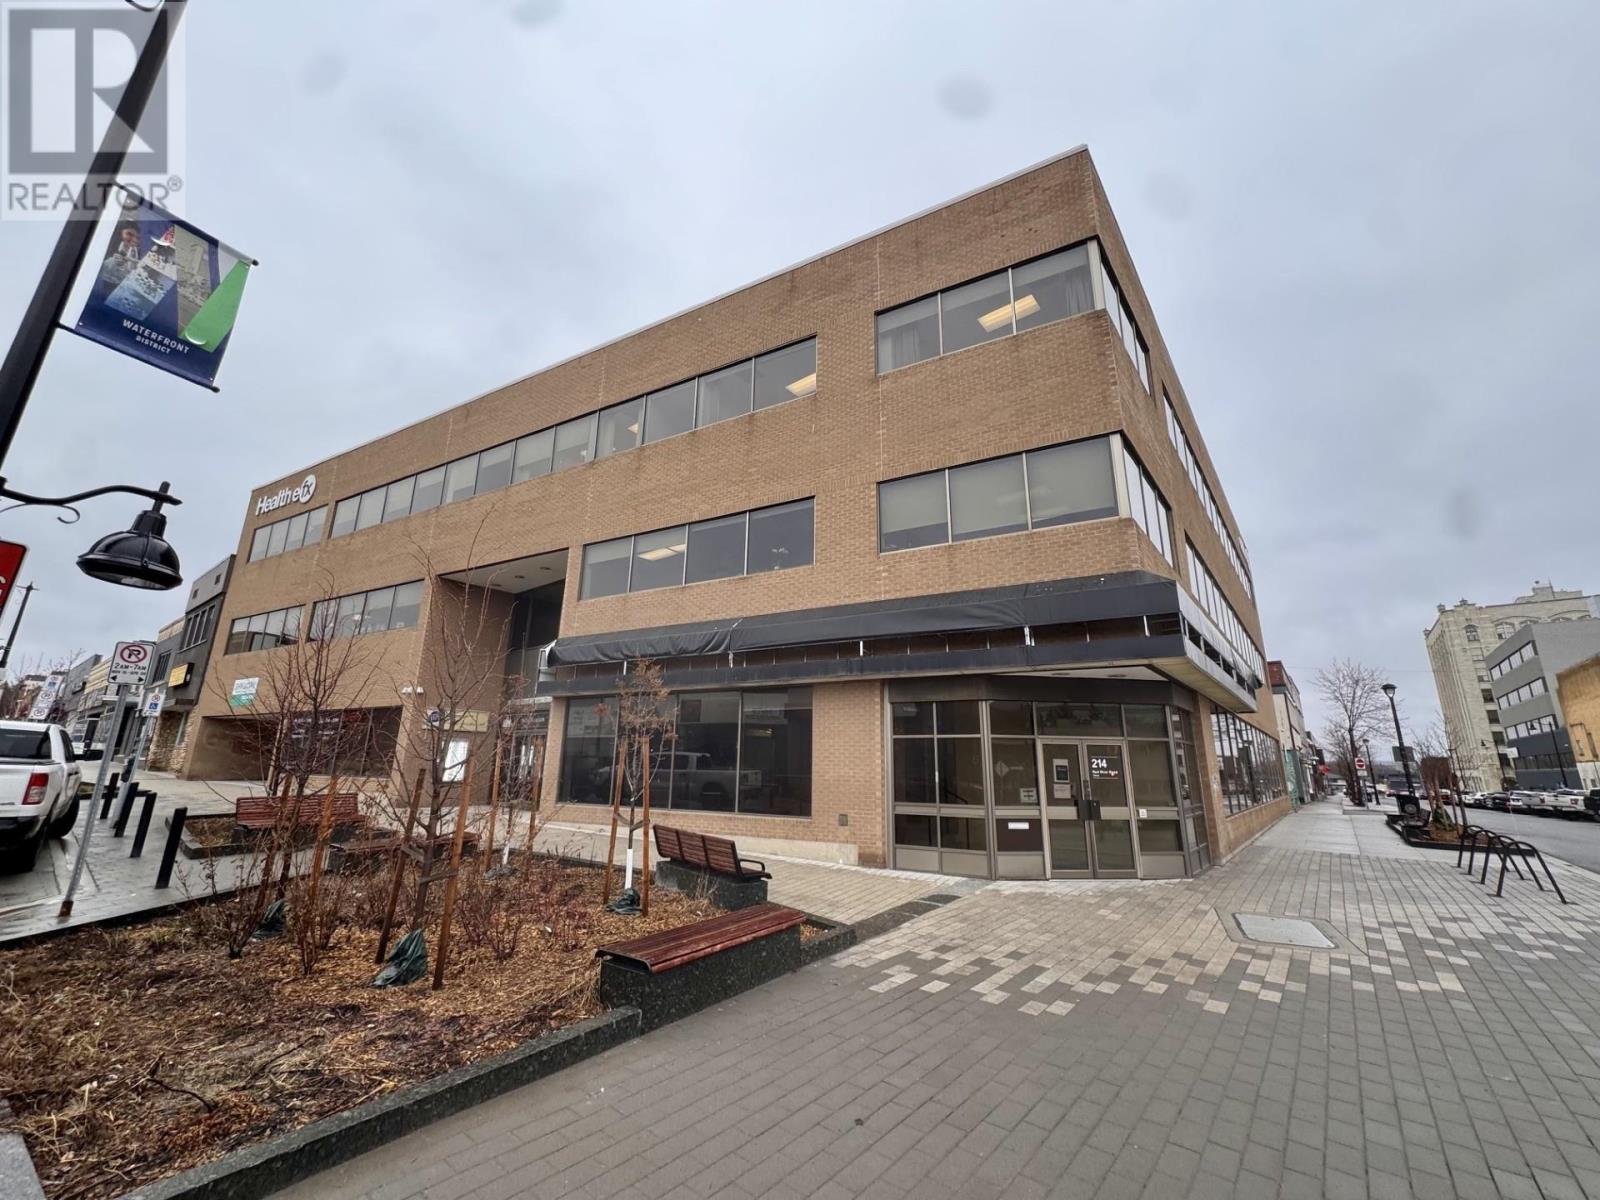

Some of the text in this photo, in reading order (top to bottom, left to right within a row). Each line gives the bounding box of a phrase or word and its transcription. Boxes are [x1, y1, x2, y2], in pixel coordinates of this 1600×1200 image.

[122, 319, 190, 355] WATERFRONT
[135, 335, 171, 354] DISTRICT
[1091, 758, 1107, 768] 214
